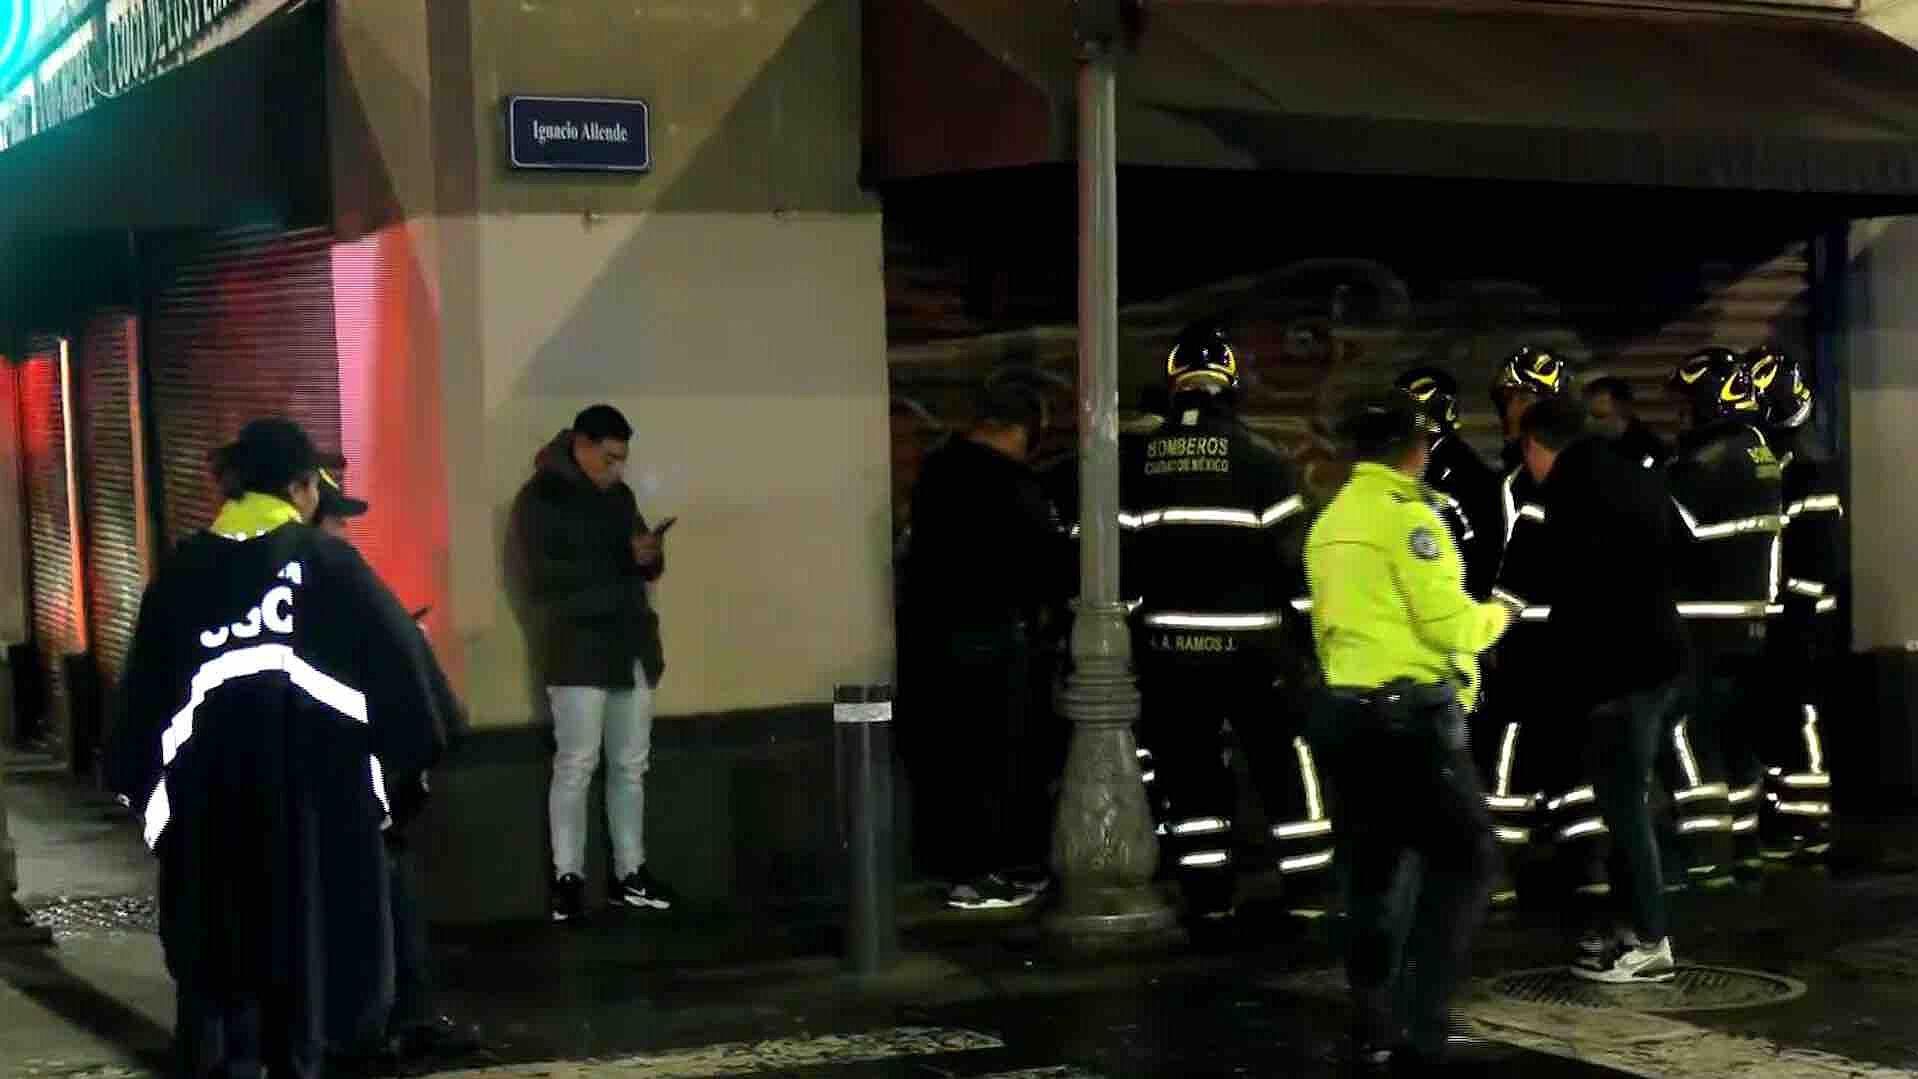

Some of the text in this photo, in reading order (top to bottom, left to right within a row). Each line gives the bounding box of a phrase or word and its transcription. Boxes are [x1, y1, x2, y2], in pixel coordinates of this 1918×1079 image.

[532, 119, 629, 144] Ignacio Allende
[1147, 437, 1229, 457] BOMBEROS
[1175, 635, 1222, 651] RAMOS
